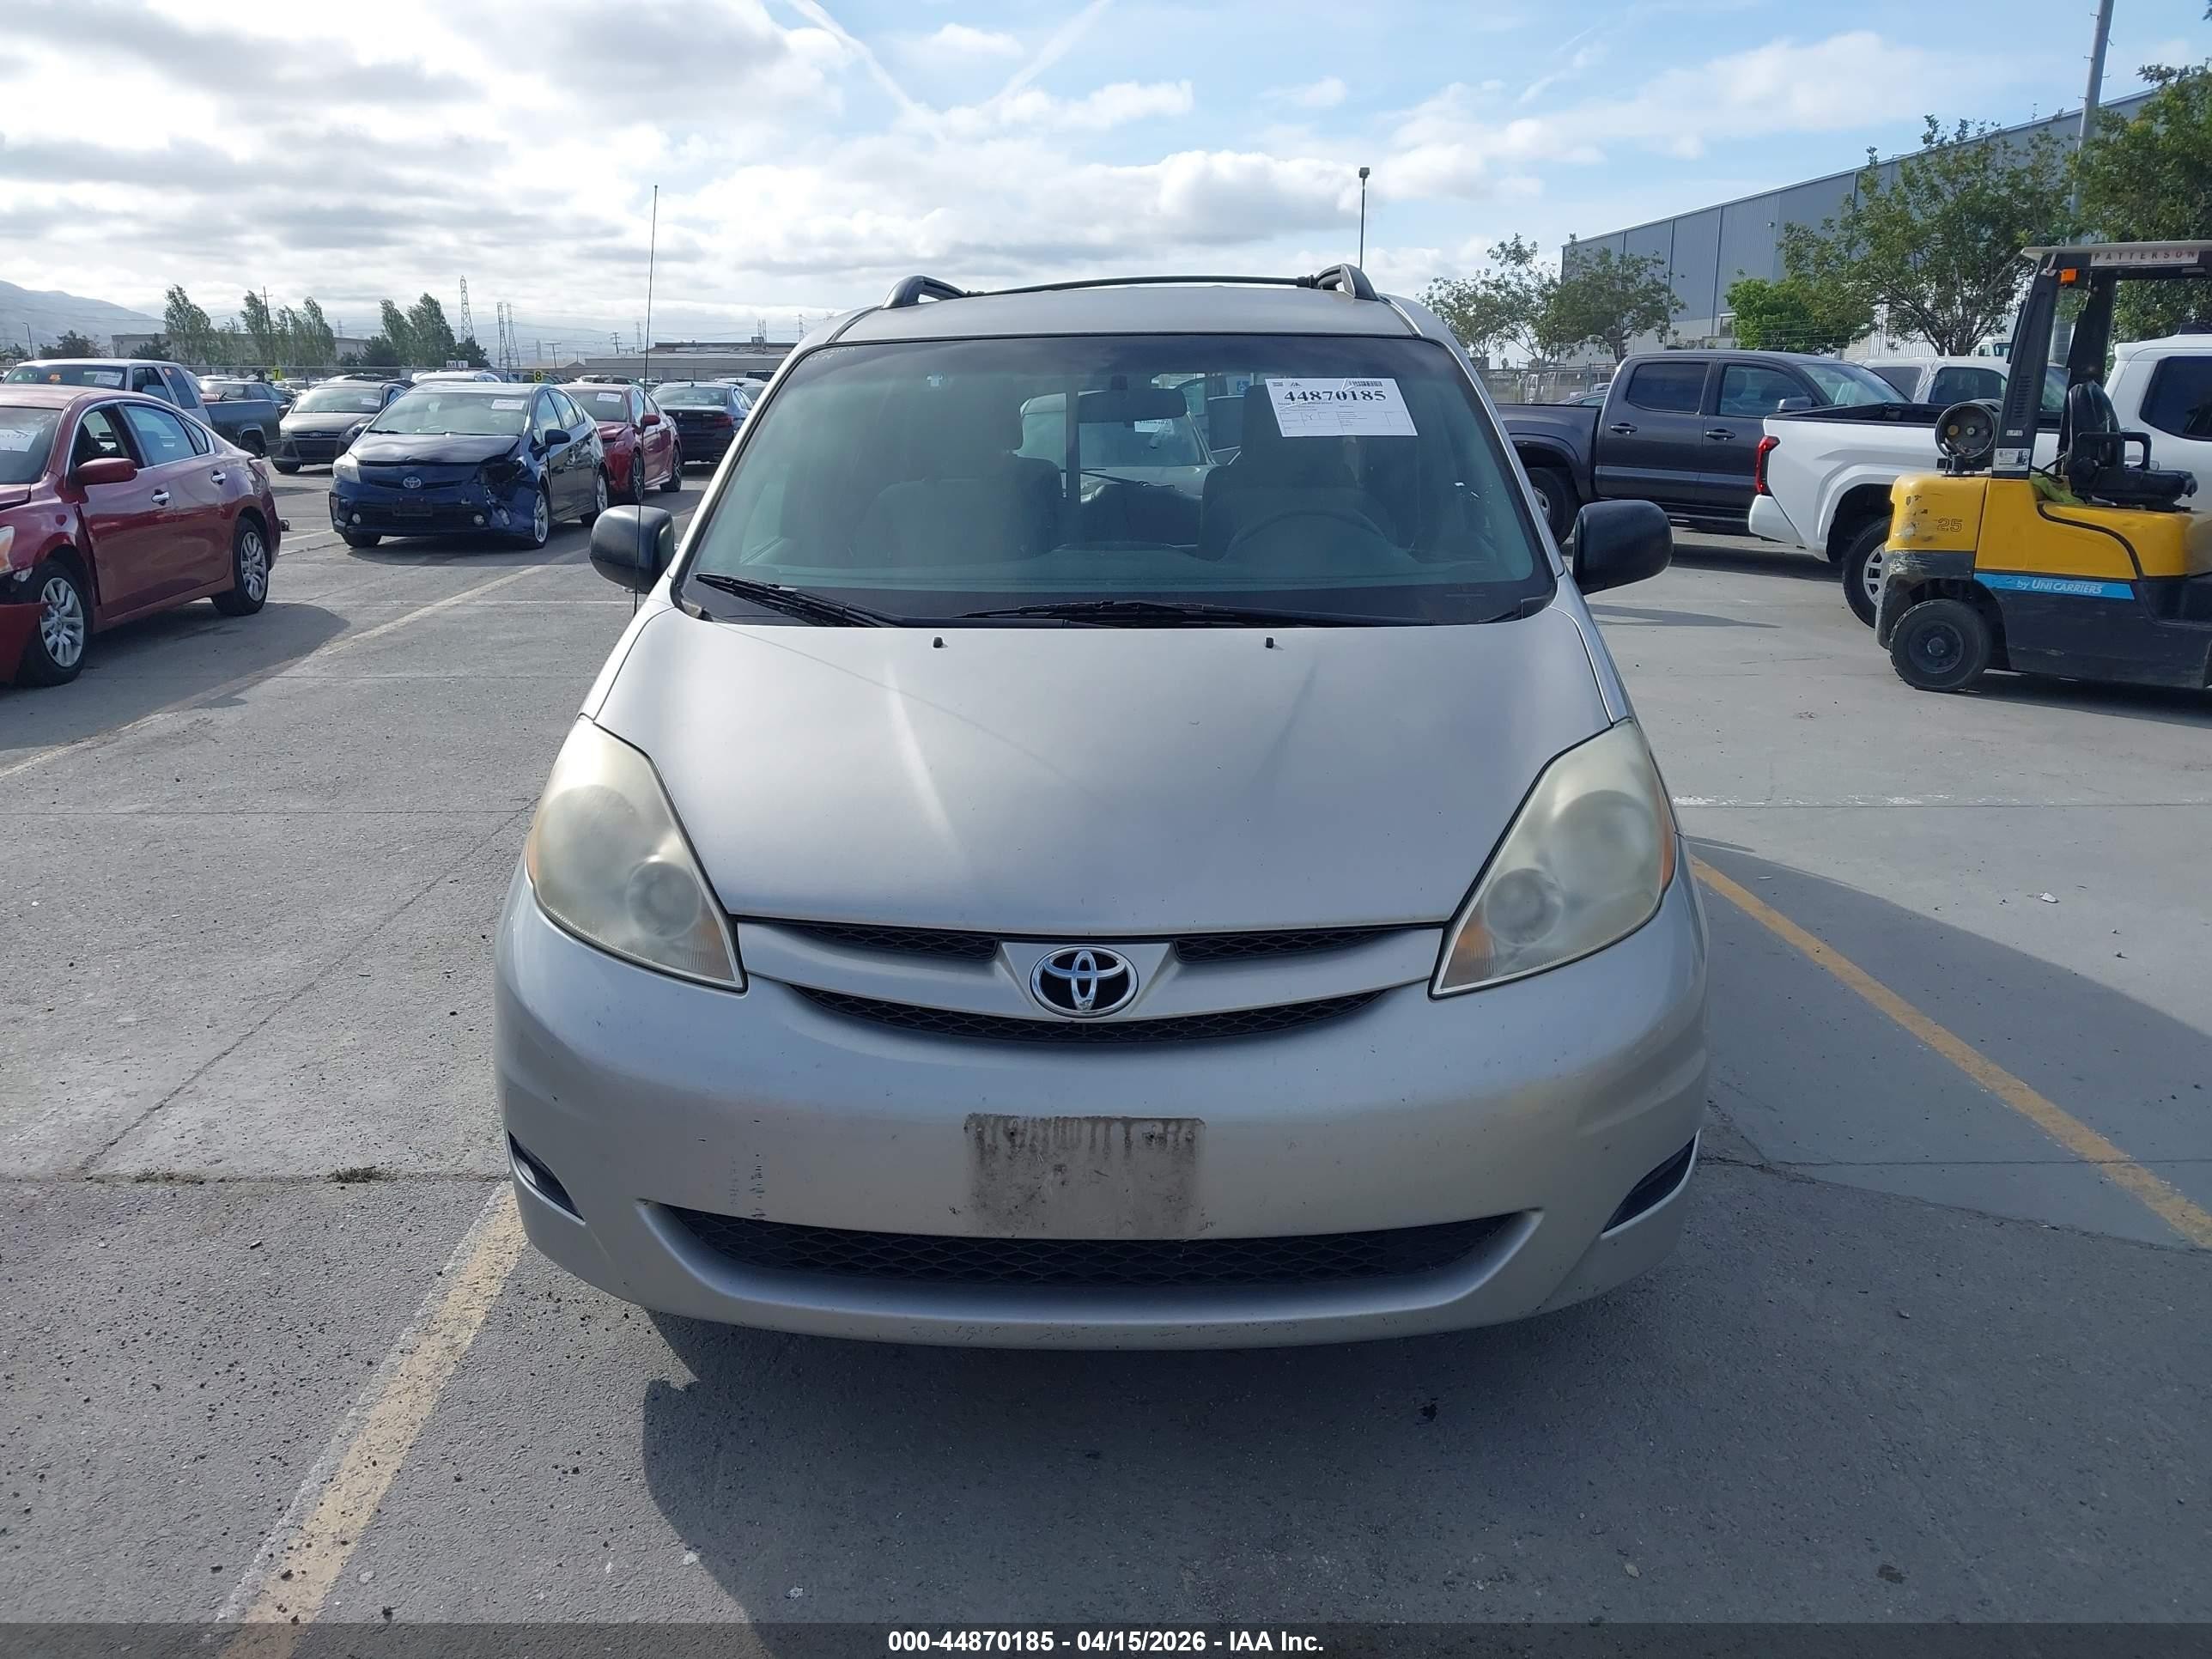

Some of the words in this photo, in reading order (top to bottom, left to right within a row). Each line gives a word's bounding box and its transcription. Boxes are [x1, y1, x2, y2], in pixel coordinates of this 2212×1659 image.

[2094, 250, 2195, 261] PATTERSON
[272, 369, 279, 379] 7
[535, 371, 542, 380] 8
[1284, 390, 1387, 402] 44870185
[1937, 518, 1964, 532] 25
[2017, 580, 2029, 590] by
